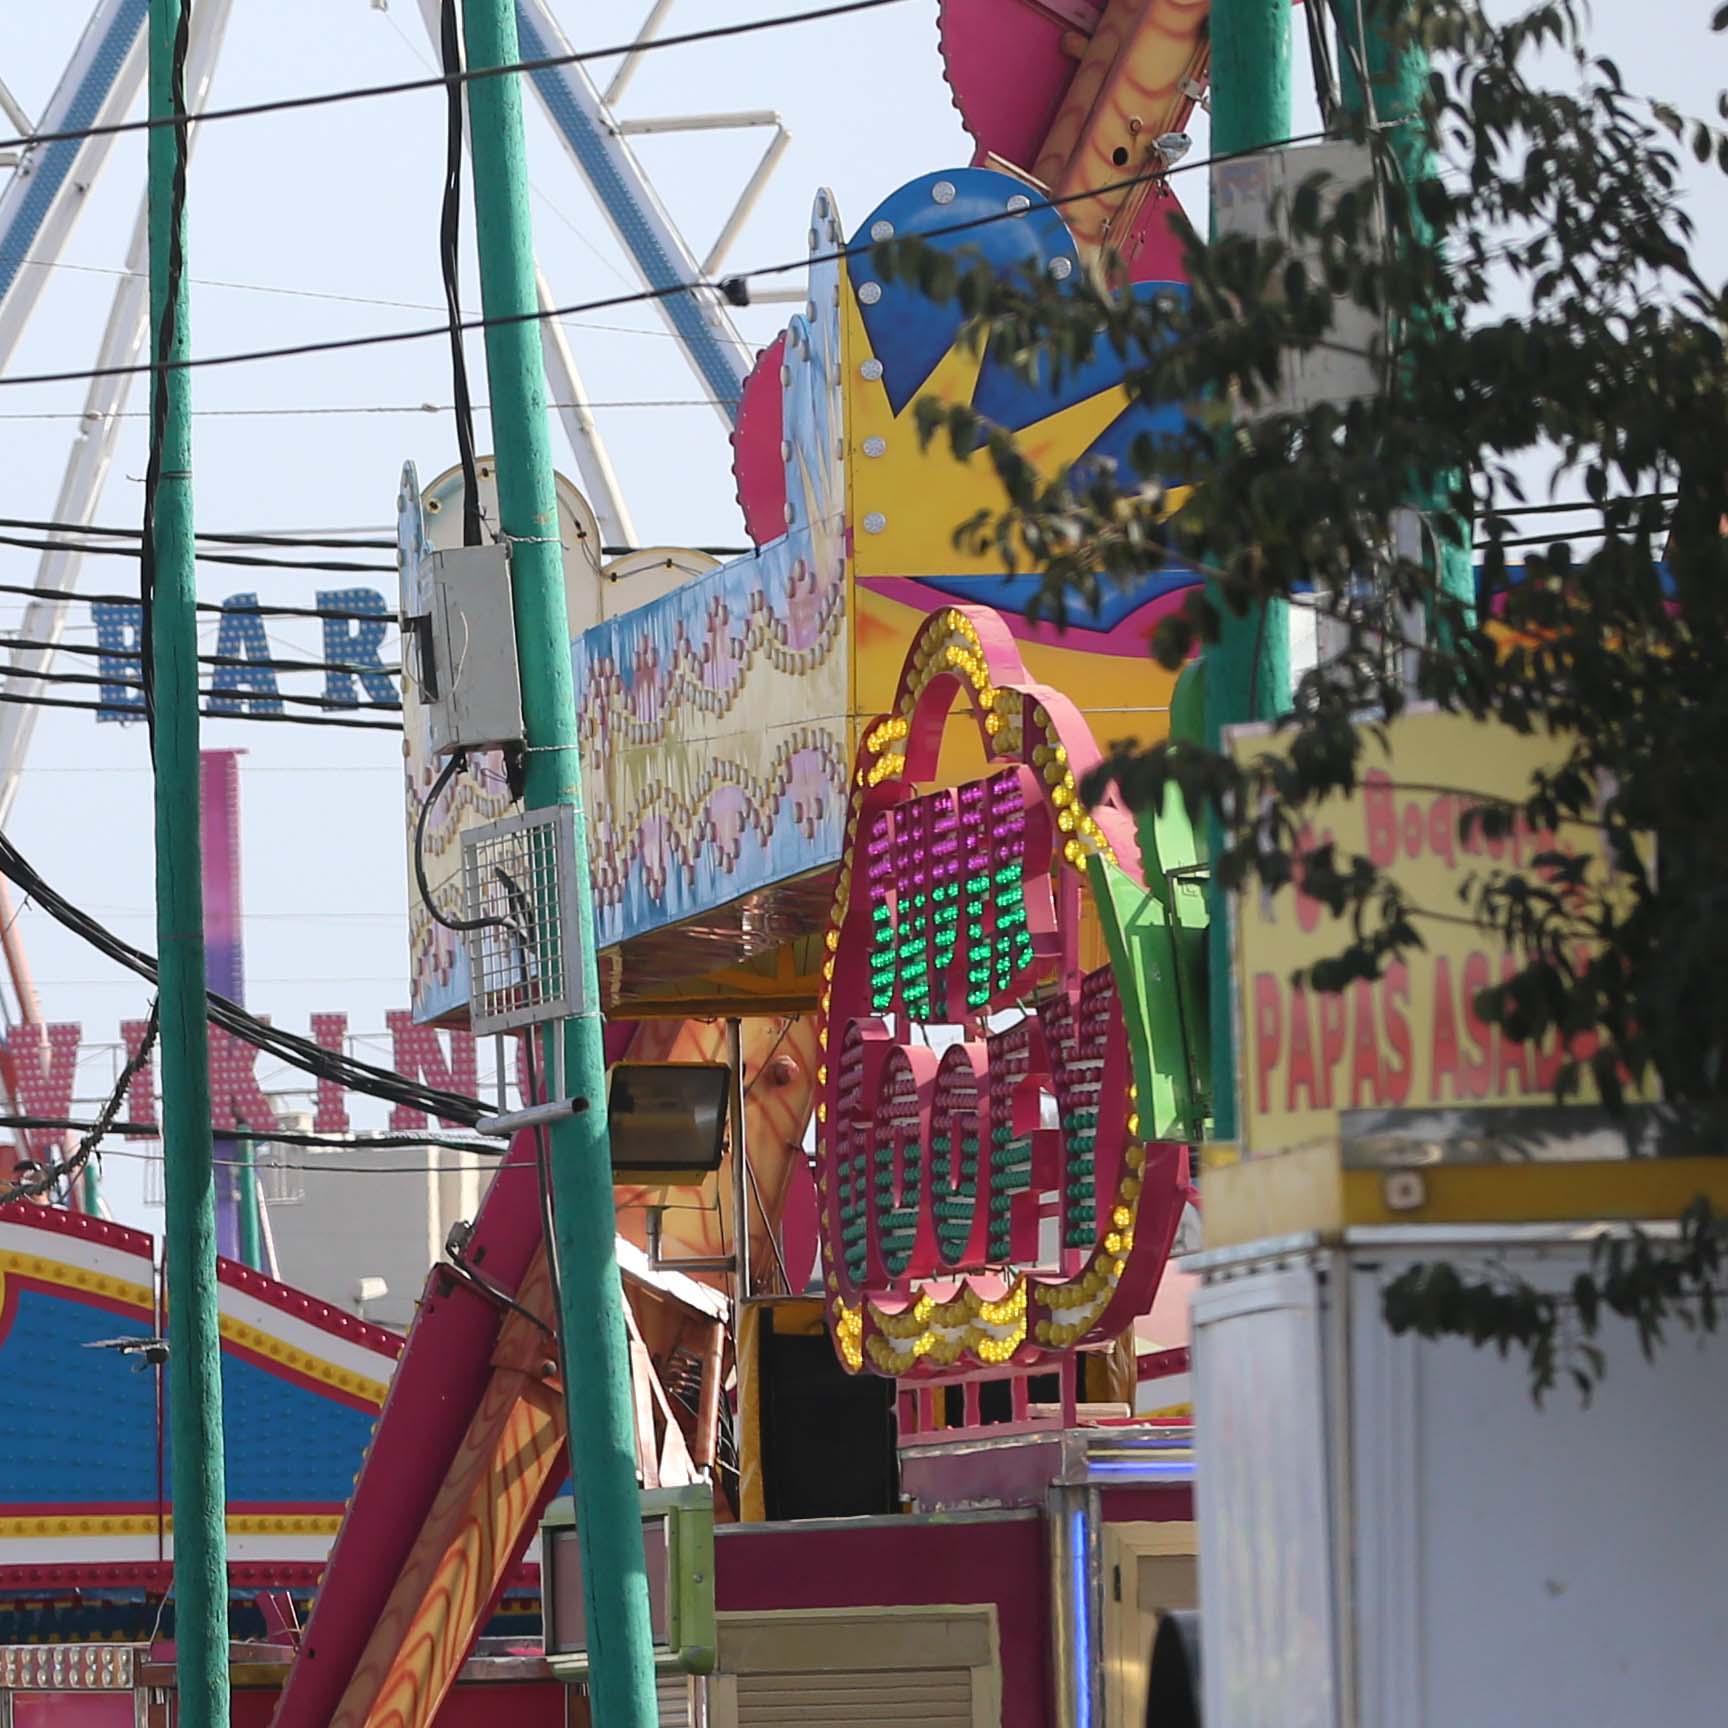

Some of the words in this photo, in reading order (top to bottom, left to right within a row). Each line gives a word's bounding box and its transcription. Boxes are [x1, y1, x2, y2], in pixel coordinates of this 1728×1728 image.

[92, 587, 401, 722] BAR
[7, 1008, 543, 1147] VIKIN
[1253, 960, 1414, 1113] PAPAS
